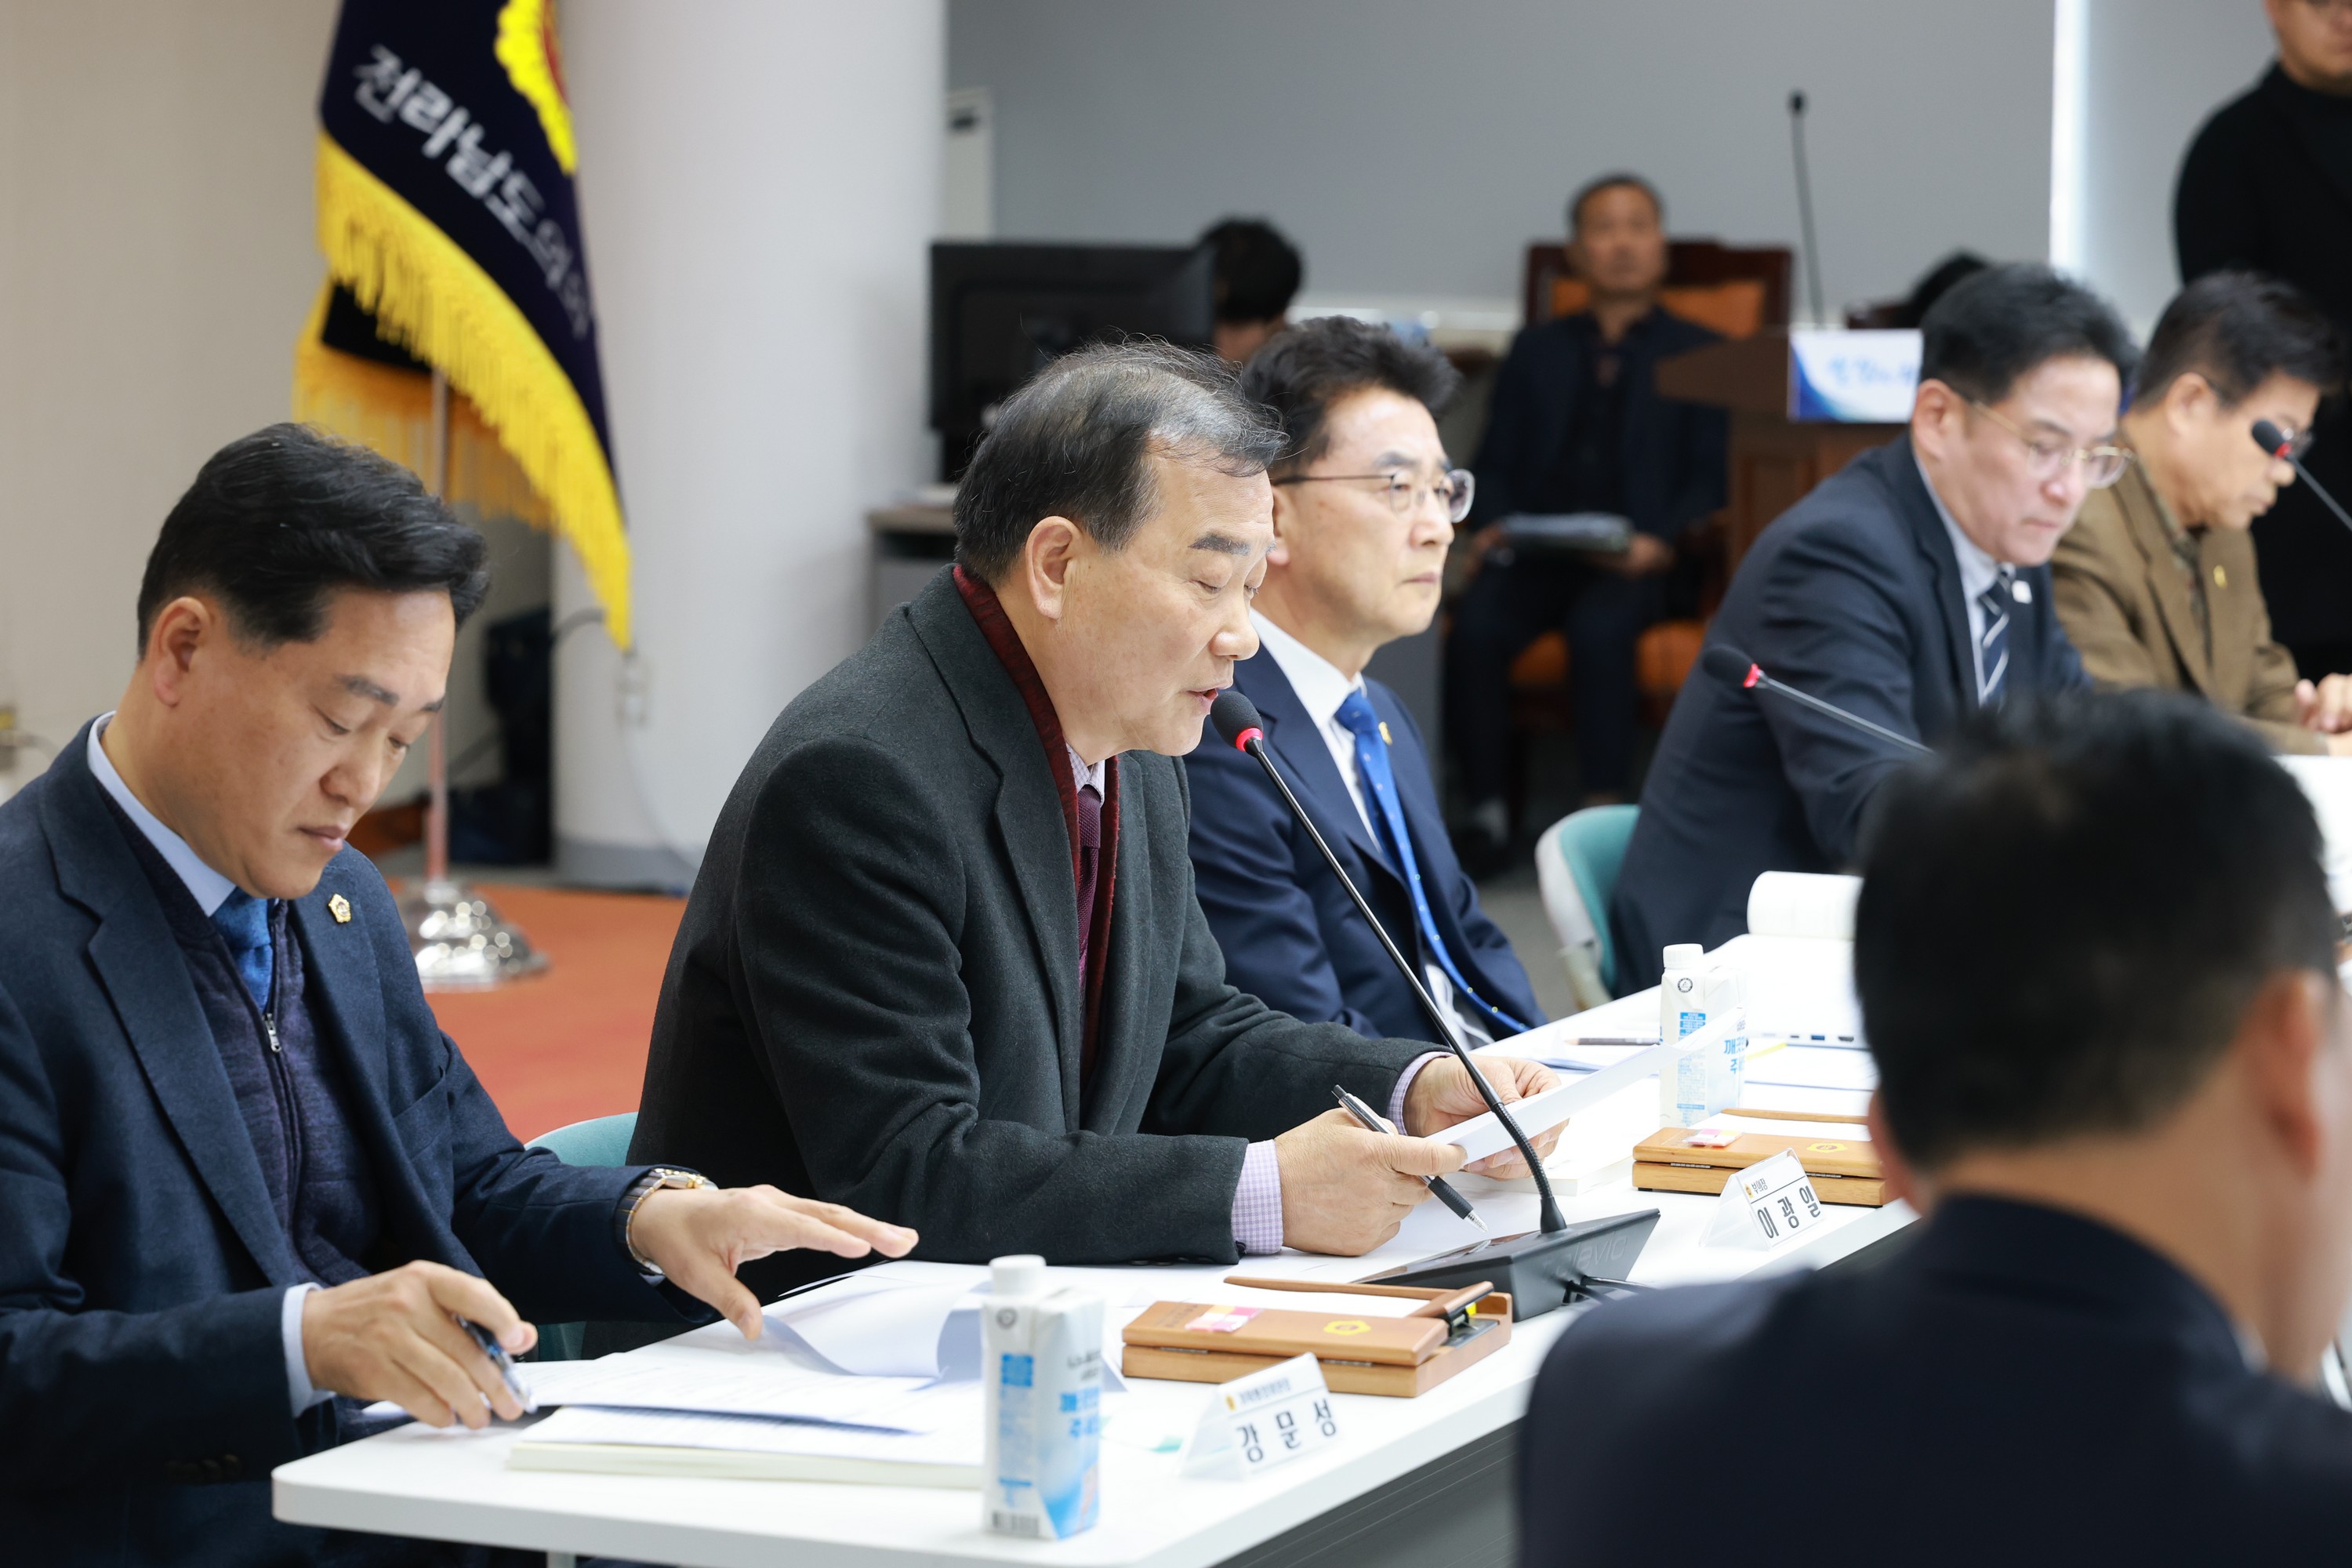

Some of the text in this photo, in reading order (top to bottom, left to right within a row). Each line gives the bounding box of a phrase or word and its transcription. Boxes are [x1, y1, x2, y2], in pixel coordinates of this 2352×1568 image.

[1751, 1178, 1768, 1194] 부의장
[1757, 1185, 1821, 1239] 이광일
[1236, 1398, 1337, 1463] 강문성
